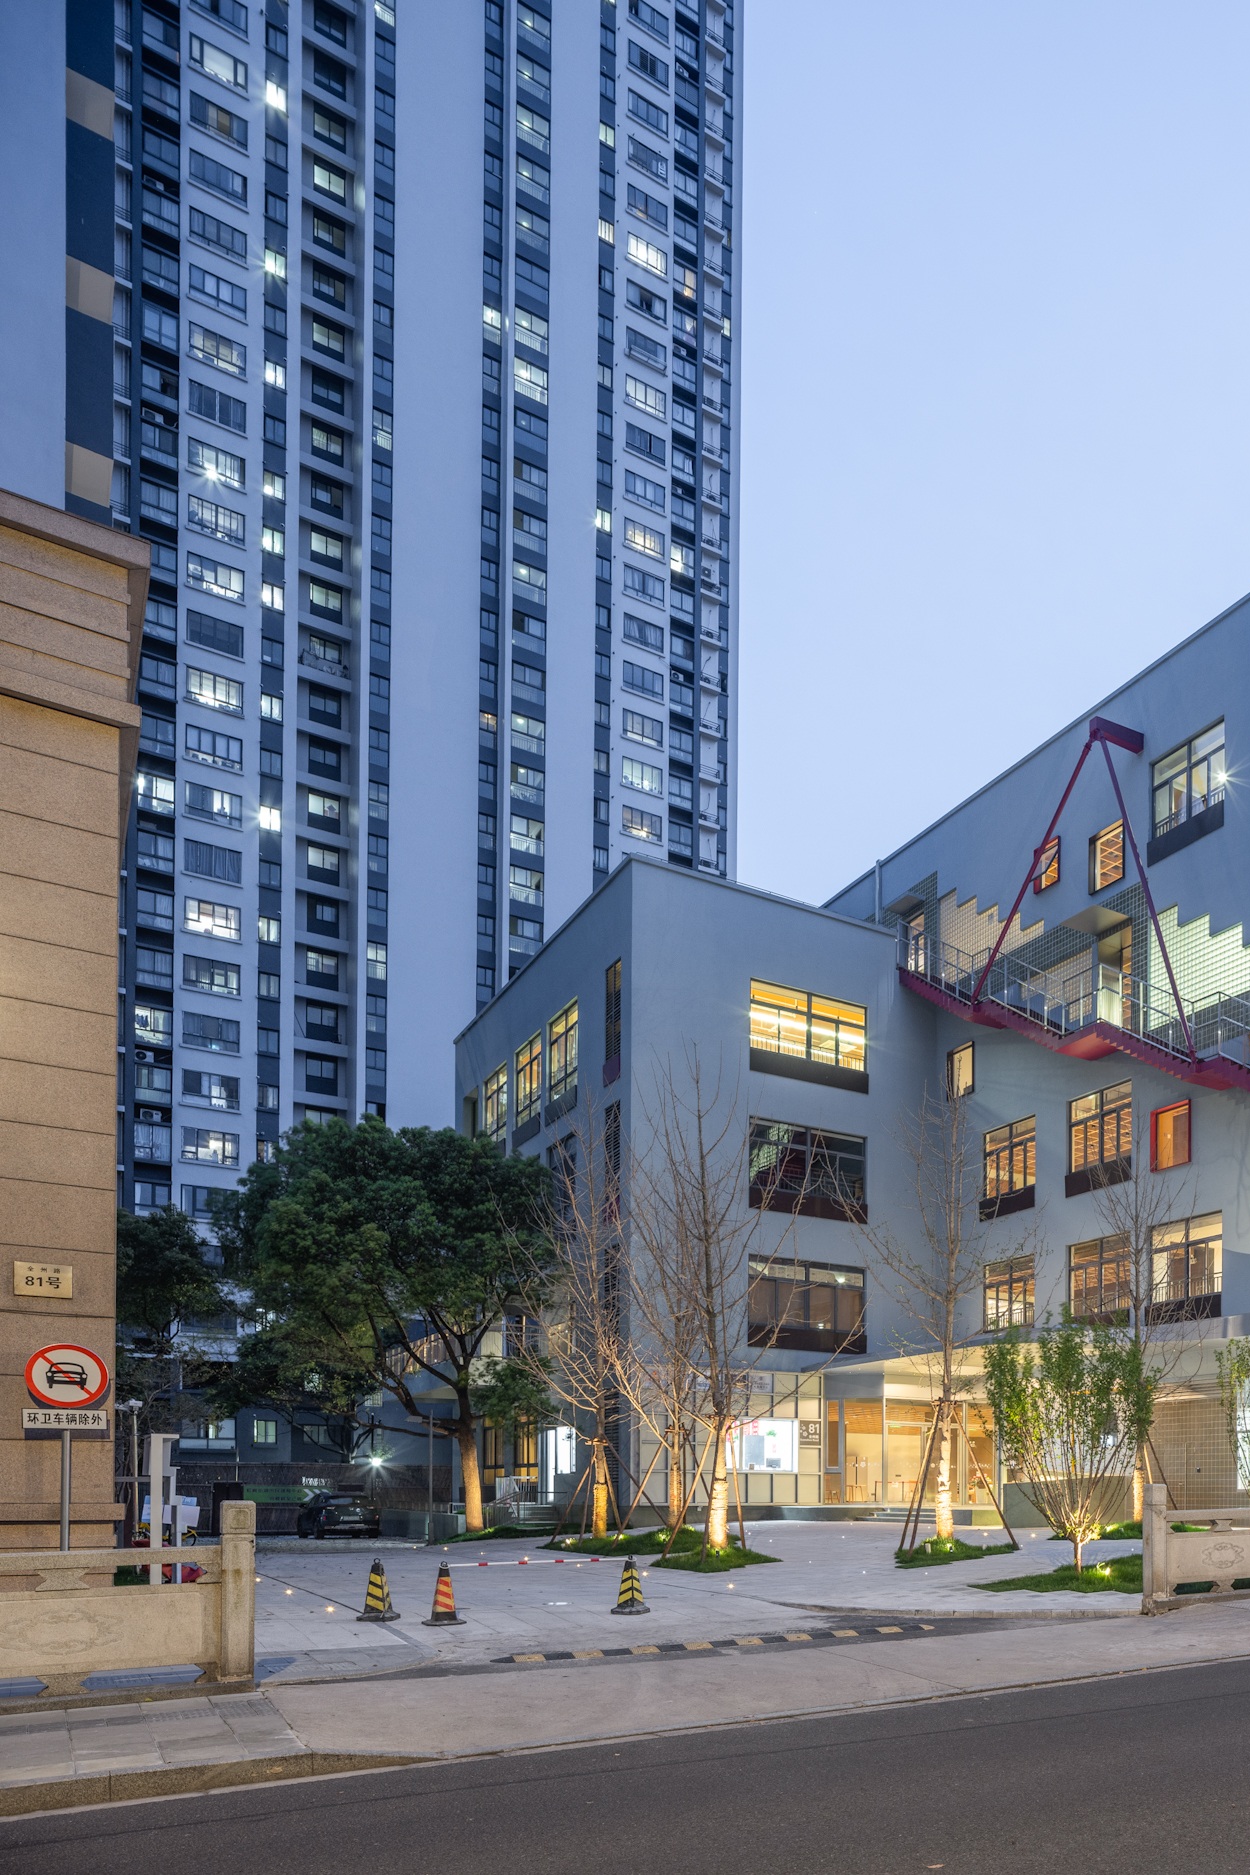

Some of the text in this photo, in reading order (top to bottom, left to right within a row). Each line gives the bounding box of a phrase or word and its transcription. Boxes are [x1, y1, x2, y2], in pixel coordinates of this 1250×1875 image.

[27, 1265, 61, 1274] 全州路
[24, 1275, 62, 1289] 81号
[27, 1412, 103, 1426] 环卫车辆除外
[808, 1423, 820, 1434] 81
